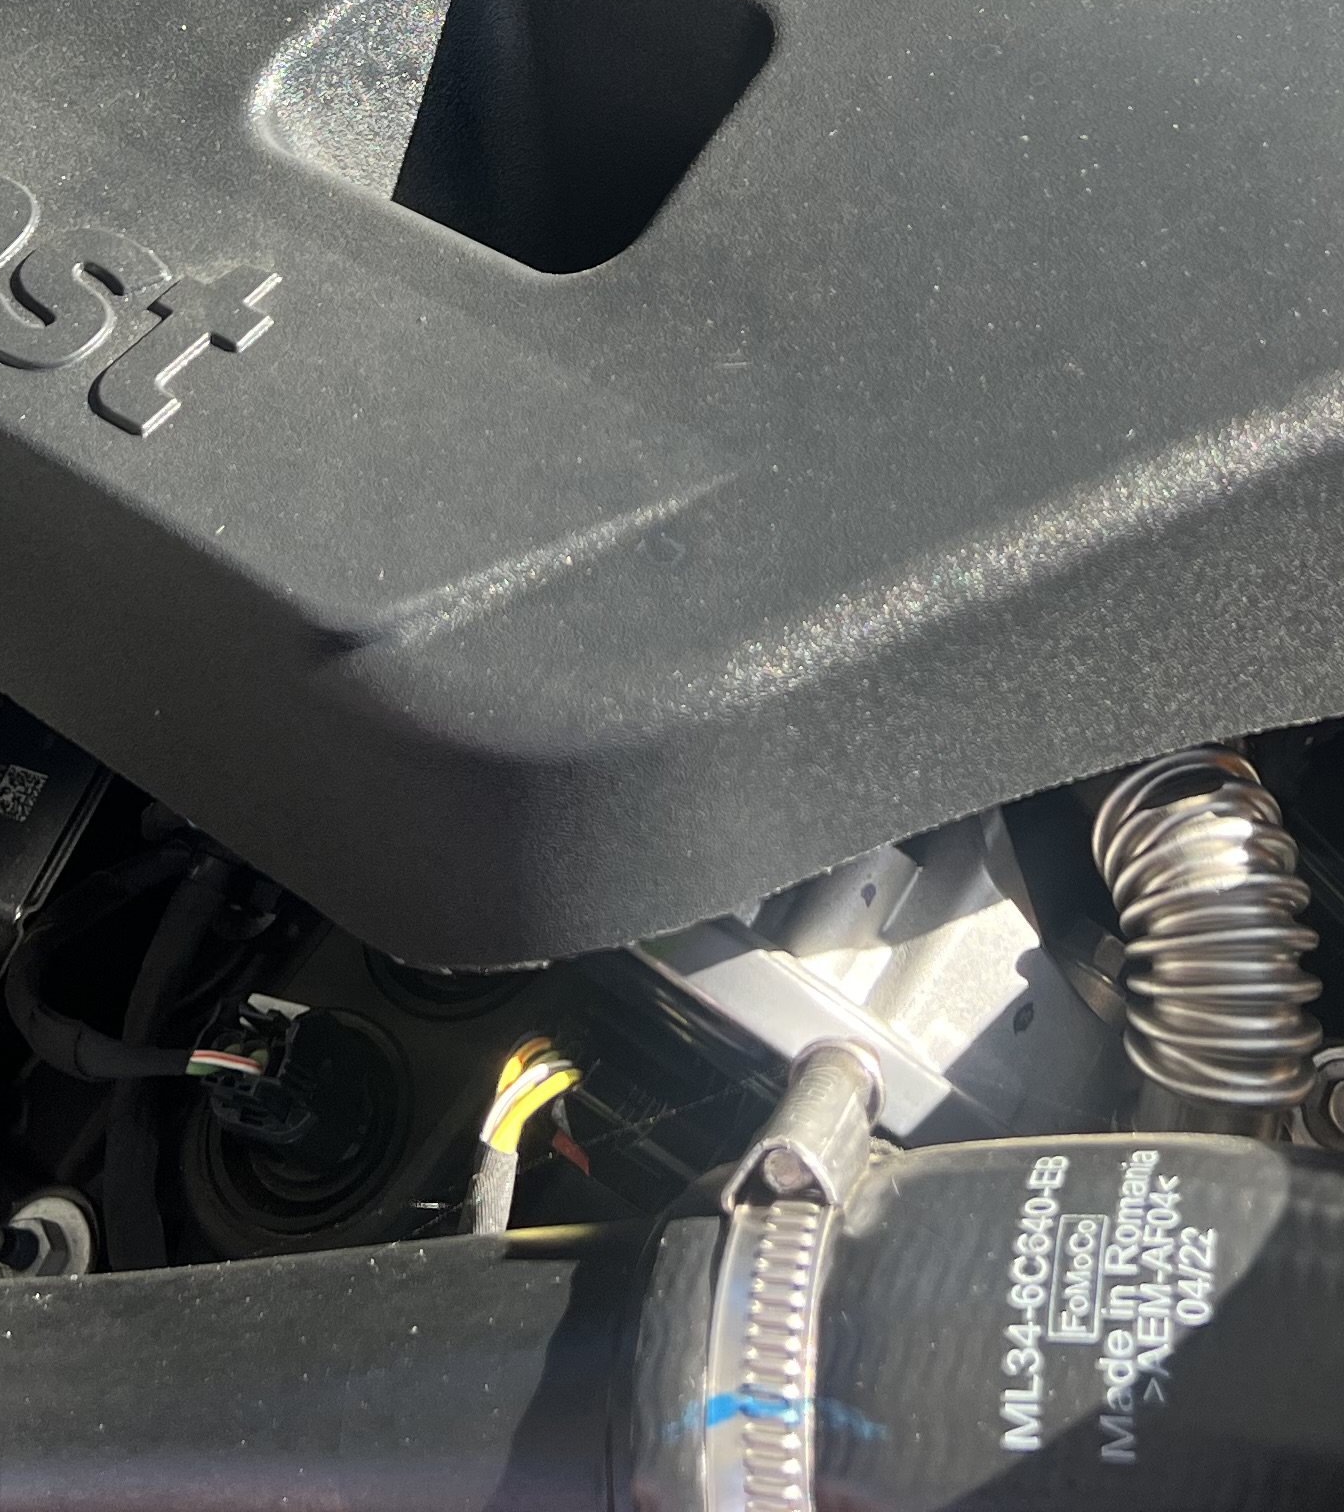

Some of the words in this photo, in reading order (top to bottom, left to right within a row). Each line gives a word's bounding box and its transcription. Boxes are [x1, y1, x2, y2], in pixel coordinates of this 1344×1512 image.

[1104, 1149, 1160, 1277] Romania
[1000, 1154, 1071, 1451] ML34-6C640-EB
[1060, 1218, 1098, 1334] FoMoCo
[1100, 1283, 1141, 1321] in
[1175, 1225, 1218, 1327] 04/22
[1096, 1328, 1137, 1465] Made
